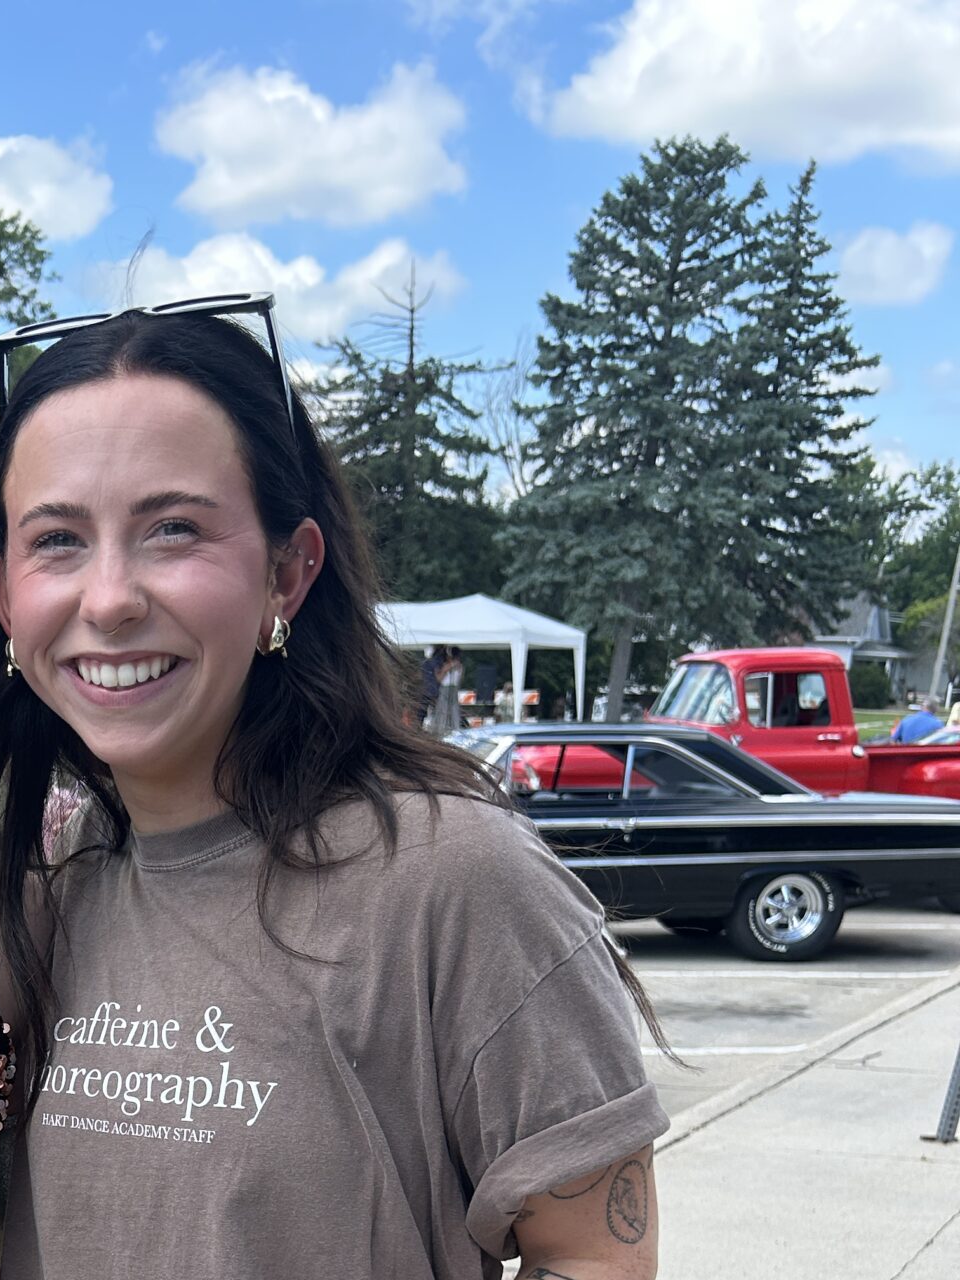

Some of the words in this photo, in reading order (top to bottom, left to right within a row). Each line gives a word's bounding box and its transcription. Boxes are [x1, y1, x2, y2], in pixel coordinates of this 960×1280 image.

[53, 1002, 180, 1050] caffeine
[195, 1005, 235, 1053] &
[40, 1051, 278, 1126] horeography
[42, 1113, 69, 1127] HART
[71, 1116, 110, 1133] DANCE
[111, 1122, 171, 1140] ACADEMY
[173, 1127, 215, 1144] STAFF
